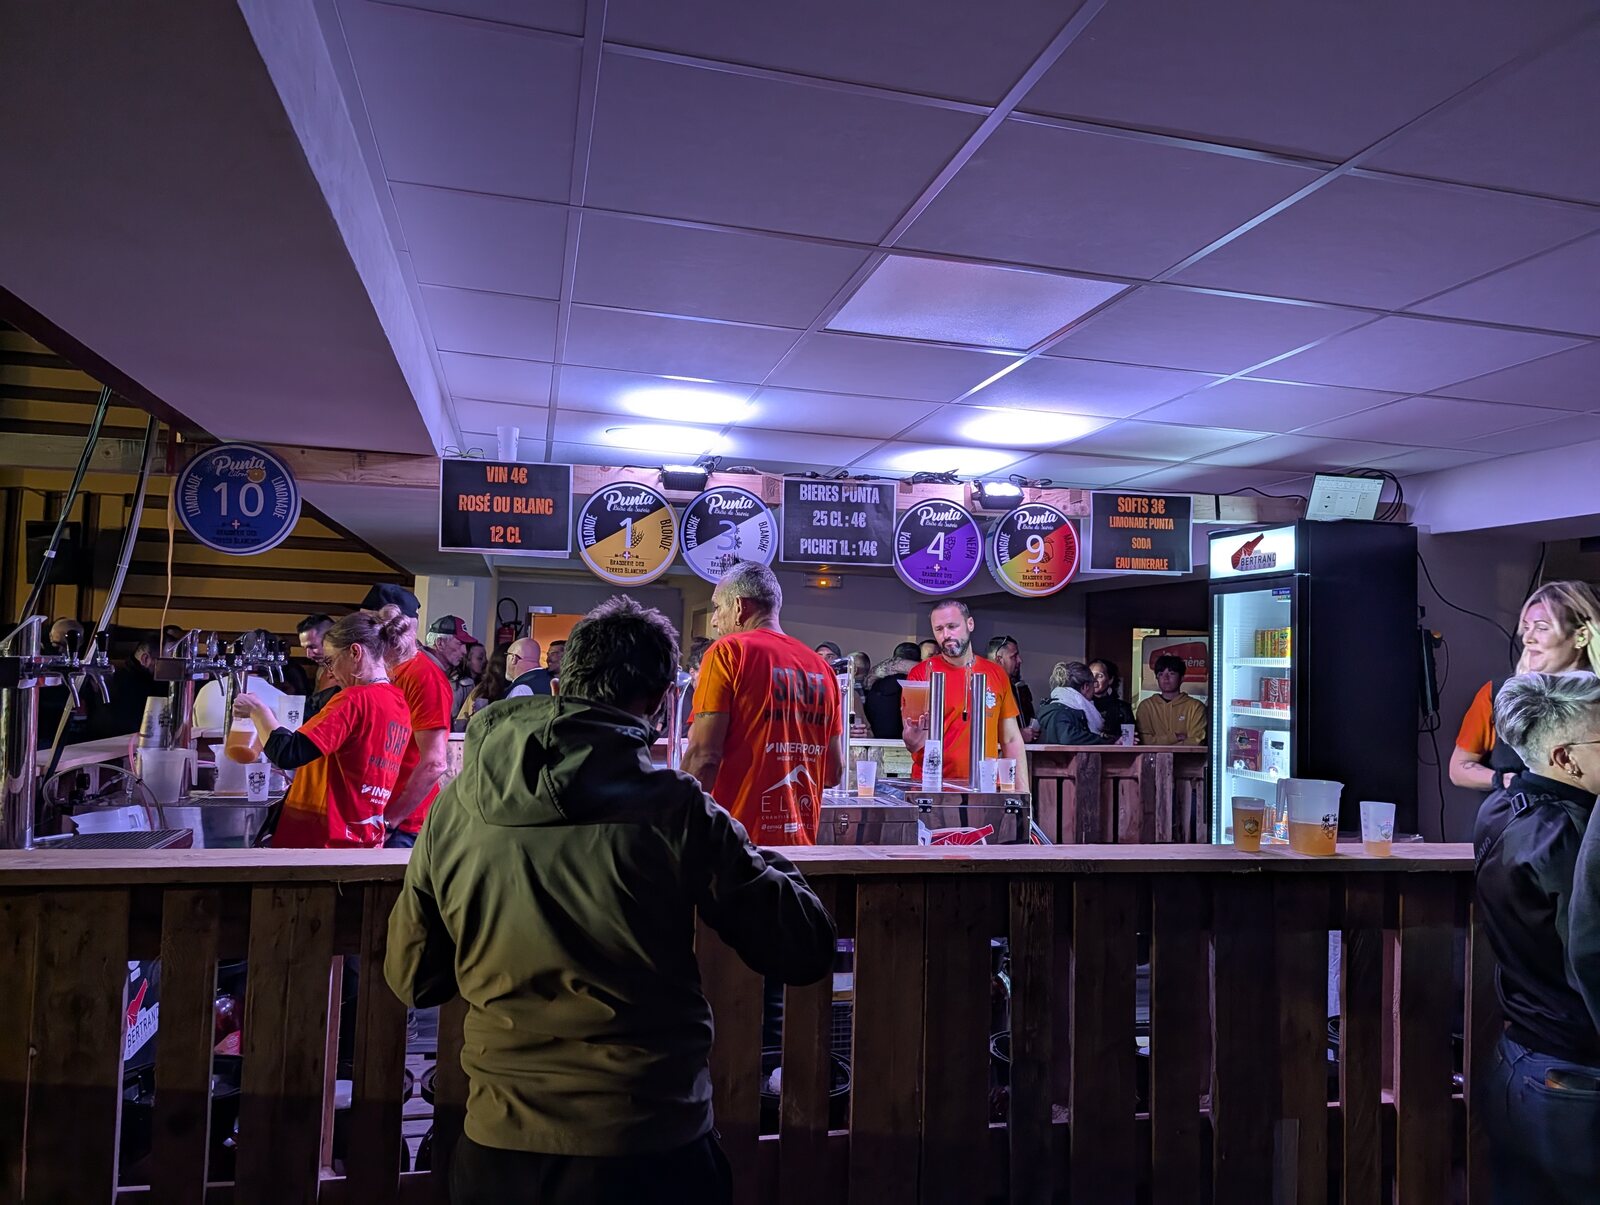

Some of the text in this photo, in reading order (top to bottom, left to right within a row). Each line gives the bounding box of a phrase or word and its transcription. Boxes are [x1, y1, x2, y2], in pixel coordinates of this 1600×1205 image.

[212, 455, 266, 476] Punta
[486, 466, 528, 484] VIN 4€
[184, 473, 203, 517] LIMONADE
[213, 482, 265, 517] 10
[271, 476, 289, 519] LIMONADE
[458, 493, 553, 515] ROSÉ OU BLANC
[603, 490, 656, 511] Punta
[705, 494, 755, 514] Punta
[800, 483, 880, 504] BIERES PUNTA
[1117, 496, 1165, 514] SOFTS 3€
[812, 510, 828, 526] 25
[829, 511, 843, 527] CL
[851, 512, 866, 528] 4€
[917, 506, 963, 526] Punta
[1014, 510, 1059, 531] Punta
[1109, 516, 1174, 530] LIMONADE PUNTA
[490, 526, 522, 543] 12 CL
[583, 513, 598, 546] BLONDE
[619, 517, 632, 548] 1
[658, 519, 673, 552] BLONDE
[686, 514, 701, 549] BLANCHE
[717, 520, 737, 551] 3
[758, 521, 769, 553] BLANCHE
[800, 538, 837, 555] PICHET
[840, 540, 850, 556] 1L
[858, 540, 878, 556] 14€
[899, 531, 911, 555] NEIPA
[926, 532, 945, 561] 4
[965, 536, 976, 560] NEIPA
[999, 532, 1011, 564] MANGUE
[1026, 534, 1045, 564] 9
[1063, 534, 1075, 564] MANGUE
[1131, 537, 1151, 550] SODA
[1115, 557, 1168, 570] EAU MINERALE
[1241, 552, 1276, 566] BERTRAND
[773, 668, 826, 706] STAFF
